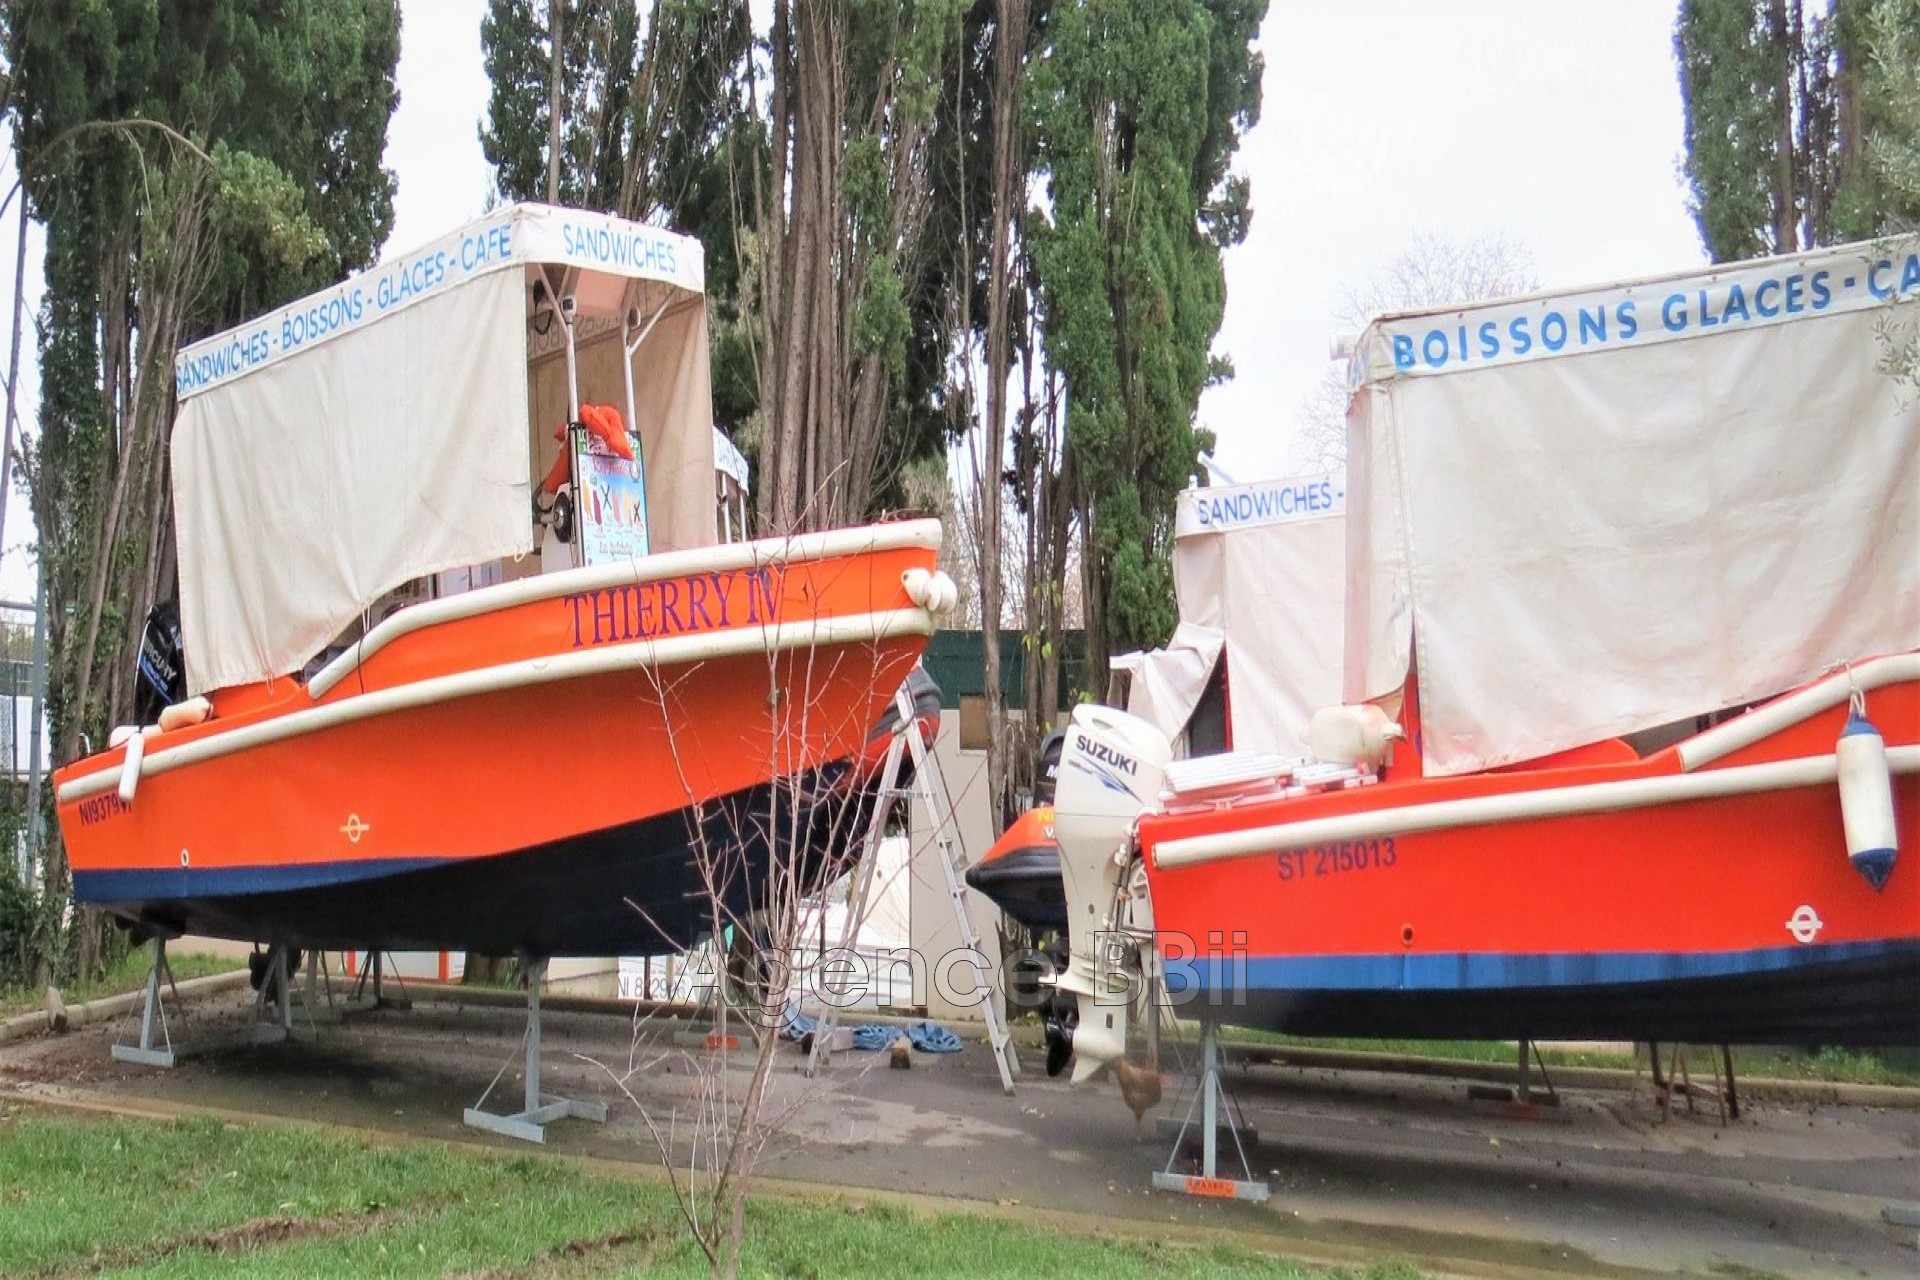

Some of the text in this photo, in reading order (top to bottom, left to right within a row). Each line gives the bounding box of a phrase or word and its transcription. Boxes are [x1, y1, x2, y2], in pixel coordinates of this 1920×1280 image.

[563, 223, 676, 274] SANDWICHES
[176, 330, 269, 393] SANDWICHES
[282, 288, 362, 350] BOISSONS
[377, 251, 445, 310] GLACES
[461, 223, 512, 273] CAFE
[1392, 302, 1639, 372] BOISSONS
[1660, 270, 1832, 333] GLACES
[1199, 481, 1332, 525] SANDWICHES
[564, 563, 788, 648] THIERRY IV
[1076, 735, 1137, 776] SUZUKI
[1278, 836, 1396, 881] ST 215013
